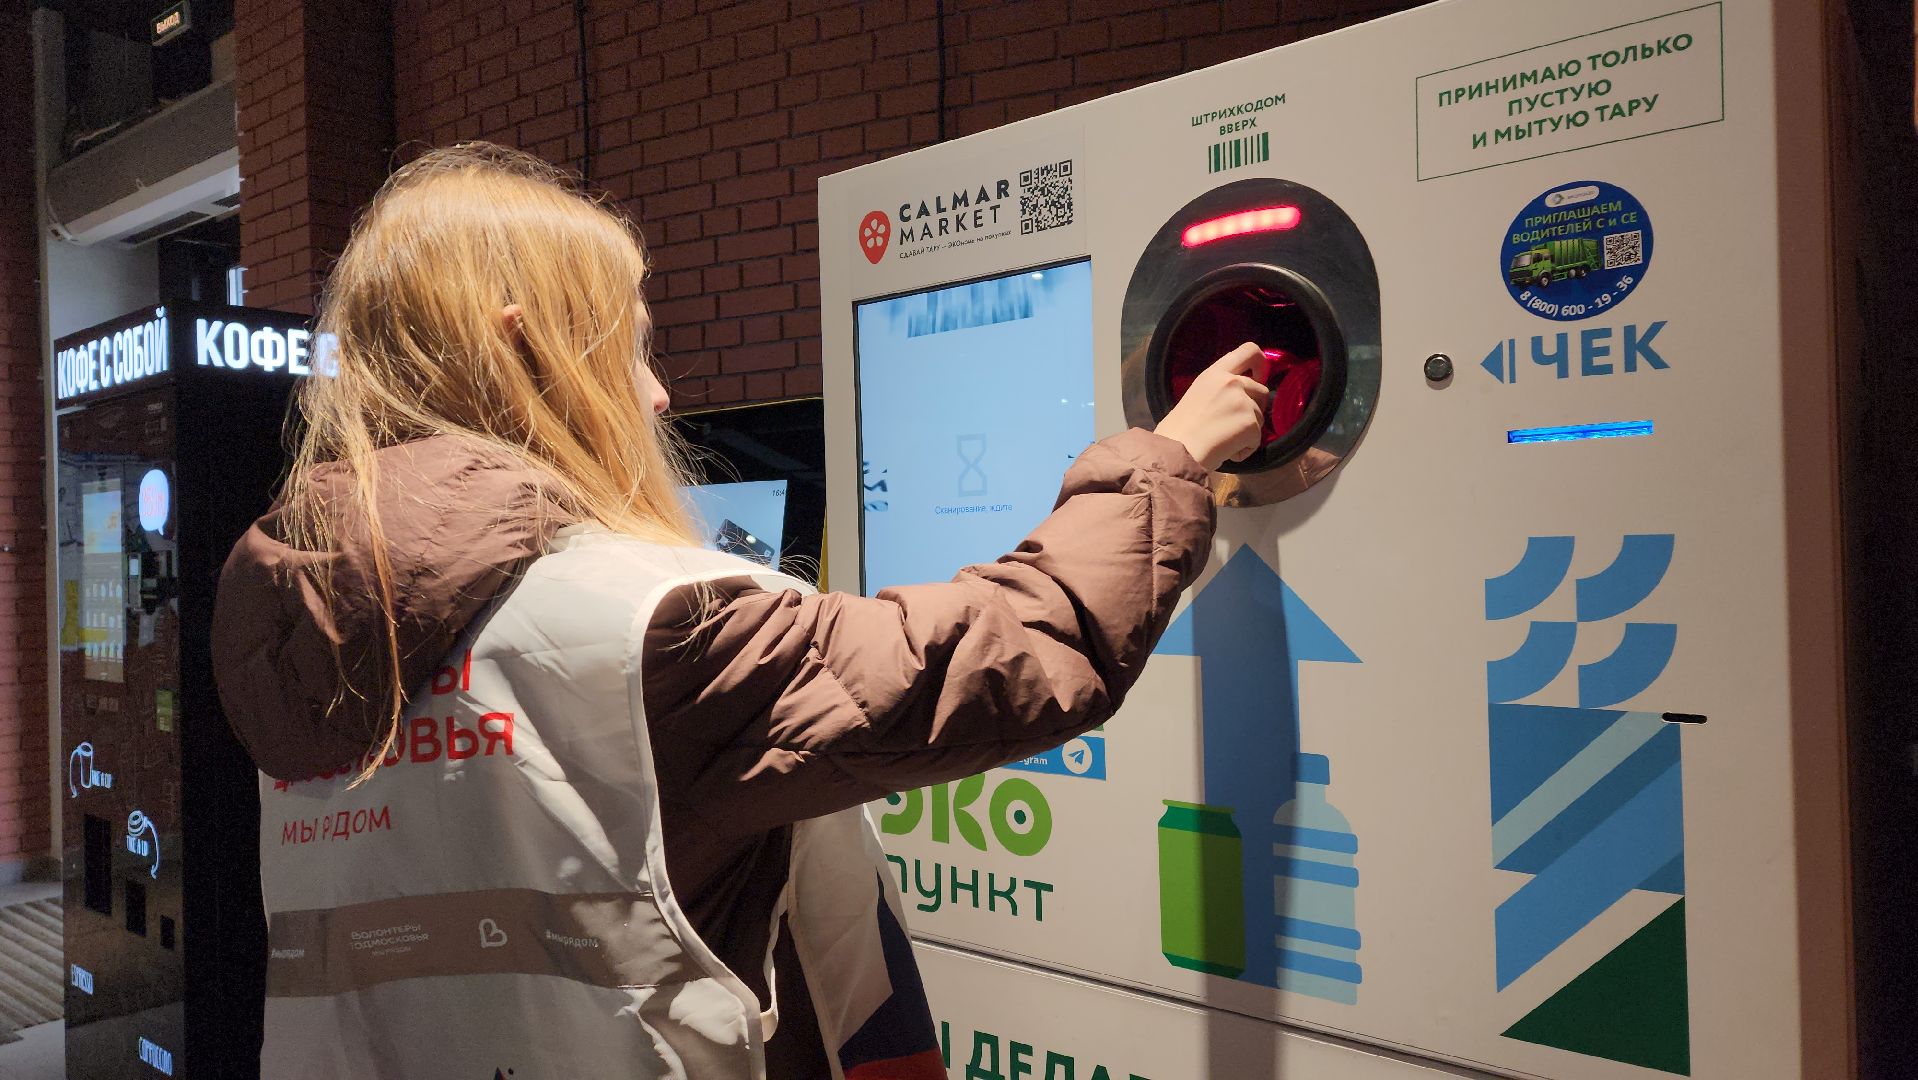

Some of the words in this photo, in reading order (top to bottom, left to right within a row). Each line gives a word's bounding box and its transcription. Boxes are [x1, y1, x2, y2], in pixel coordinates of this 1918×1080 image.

[1438, 59, 1582, 107] ПРИНИМАЮ
[1587, 33, 1693, 71] ТОЛЬКО
[1191, 92, 1287, 127] ШТРИХКОДОМ
[1507, 78, 1612, 117] ПУСТУЮ
[1219, 117, 1257, 136] ВВЕРХ
[1471, 131, 1487, 150] И
[1494, 110, 1590, 145] МЫТУЮ
[1595, 94, 1659, 122] ТАРУ
[898, 179, 1010, 223] CALMAR
[1525, 200, 1622, 228] ПРИГЛАШАЕМ
[899, 204, 1001, 246] MARKET
[1512, 219, 1592, 244] ВОДИТЕЛЕЙ
[1621, 211, 1638, 225] СЕ
[1519, 290, 1531, 301] 8
[1527, 296, 1559, 317] (800)
[1561, 303, 1585, 316] 600
[1594, 293, 1612, 308] 19
[1616, 275, 1634, 292] 36
[57, 339, 100, 400] КОФЕ
[100, 336, 112, 388] С
[113, 306, 169, 385] СОБОЙ
[196, 318, 311, 375] КОФЕ
[1531, 320, 1671, 379] ЧЕК
[772, 488, 786, 497] 16:4
[281, 817, 319, 846] МЫ
[322, 805, 392, 842] РДОМ
